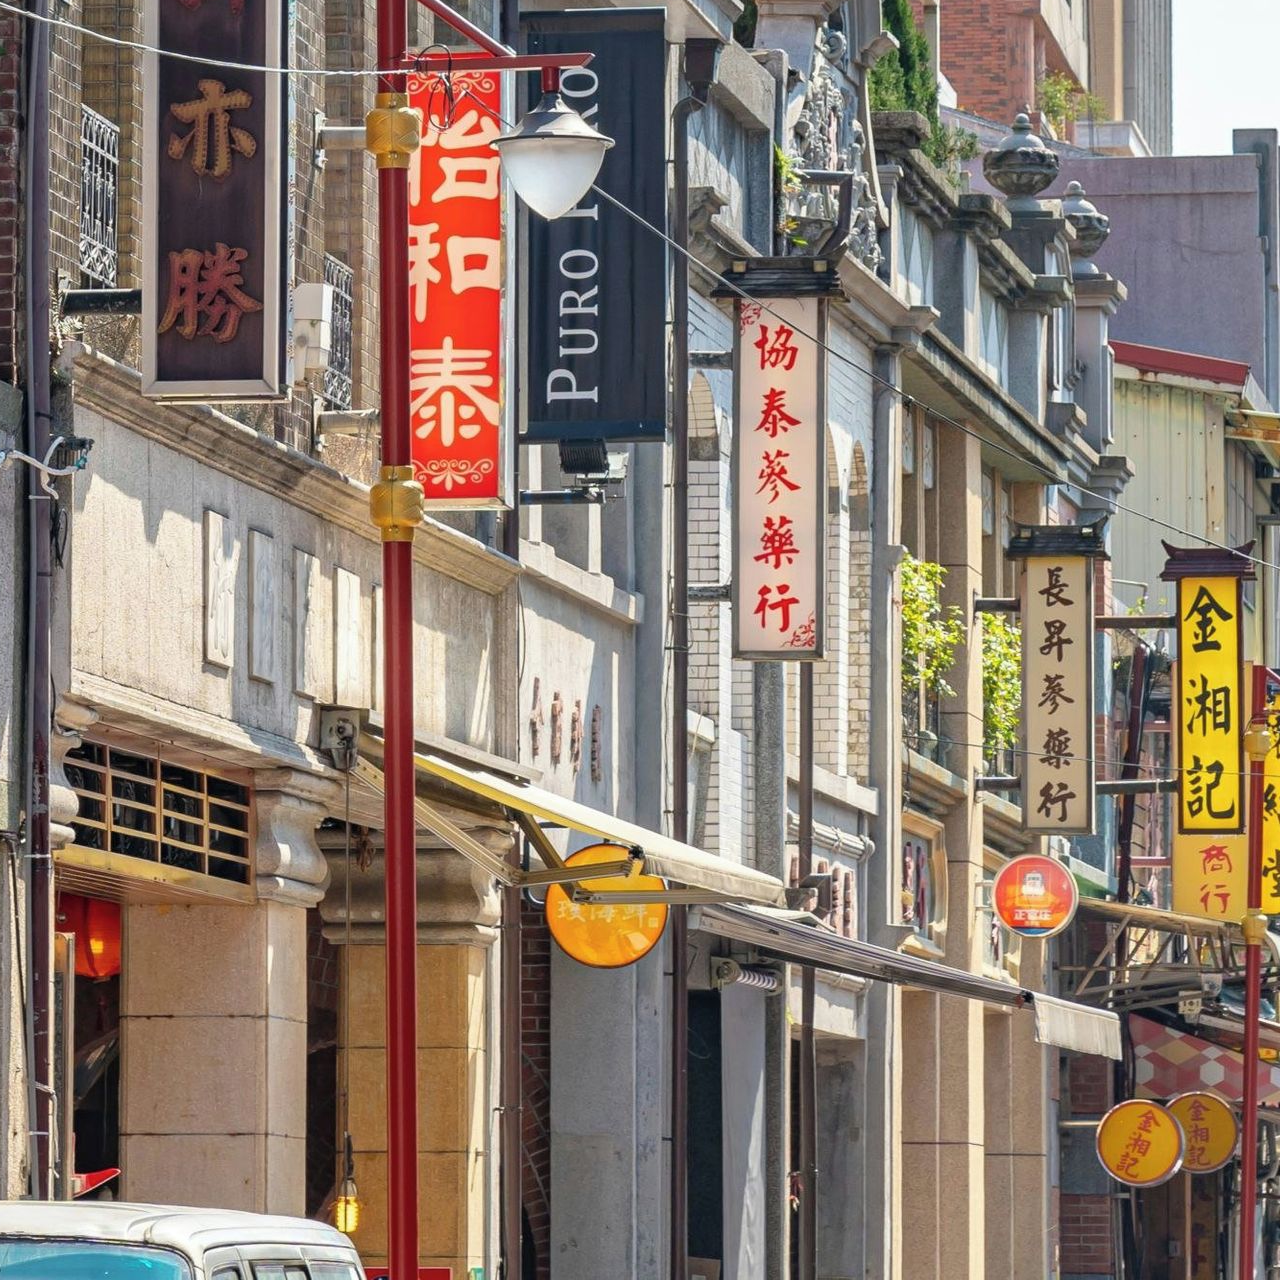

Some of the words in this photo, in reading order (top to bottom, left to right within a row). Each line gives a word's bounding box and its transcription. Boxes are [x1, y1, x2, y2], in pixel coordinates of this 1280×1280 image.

[547, 248, 599, 404] PURO
[753, 324, 801, 634] 協泰蔘藥行
[1036, 567, 1076, 822] 長昇蔘藥行
[1183, 584, 1236, 820] 金湘記
[1115, 1108, 1161, 1179] 金湘記
[1186, 1098, 1212, 1167] 金湘記
